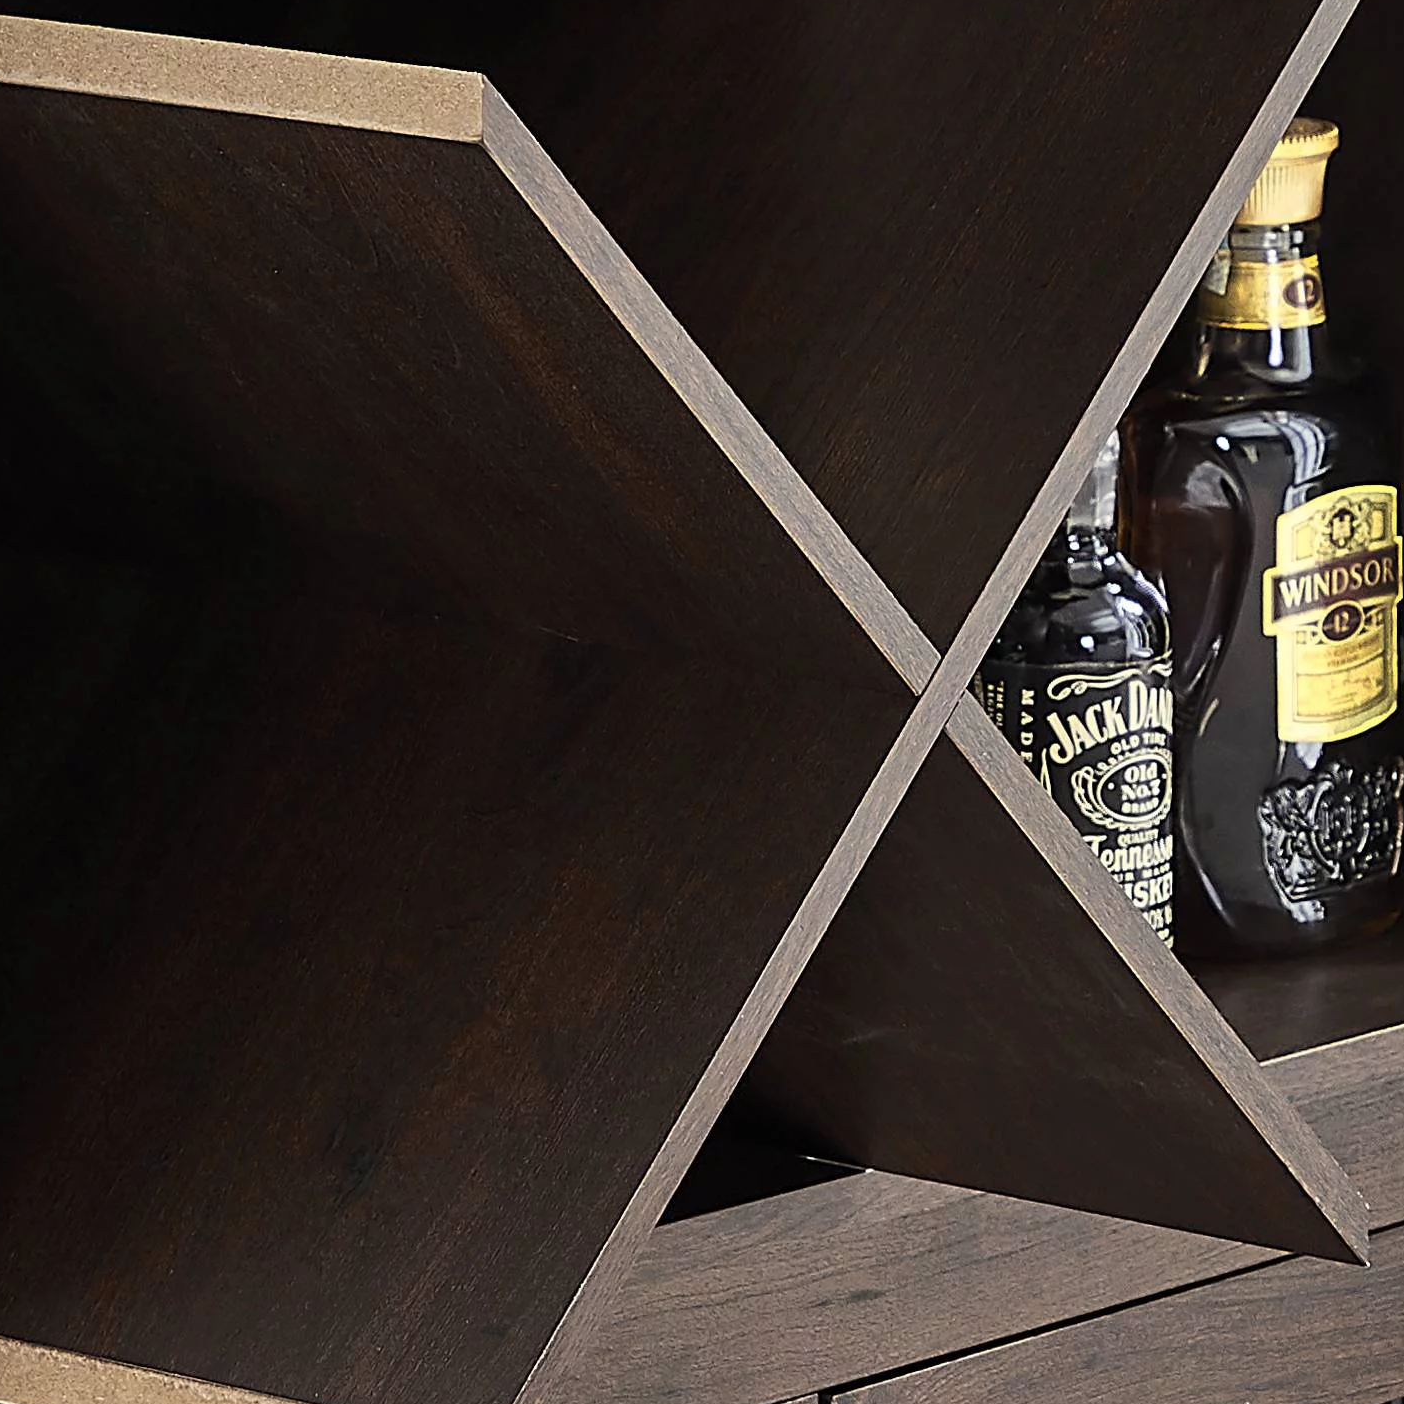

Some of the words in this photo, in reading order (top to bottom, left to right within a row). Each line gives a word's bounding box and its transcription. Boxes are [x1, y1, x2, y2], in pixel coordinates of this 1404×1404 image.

[1279, 557, 1395, 609] WINDSOR
[1046, 695, 1128, 765] JACK
[1110, 735, 1141, 756] OLD
[1124, 762, 1158, 784] Old
